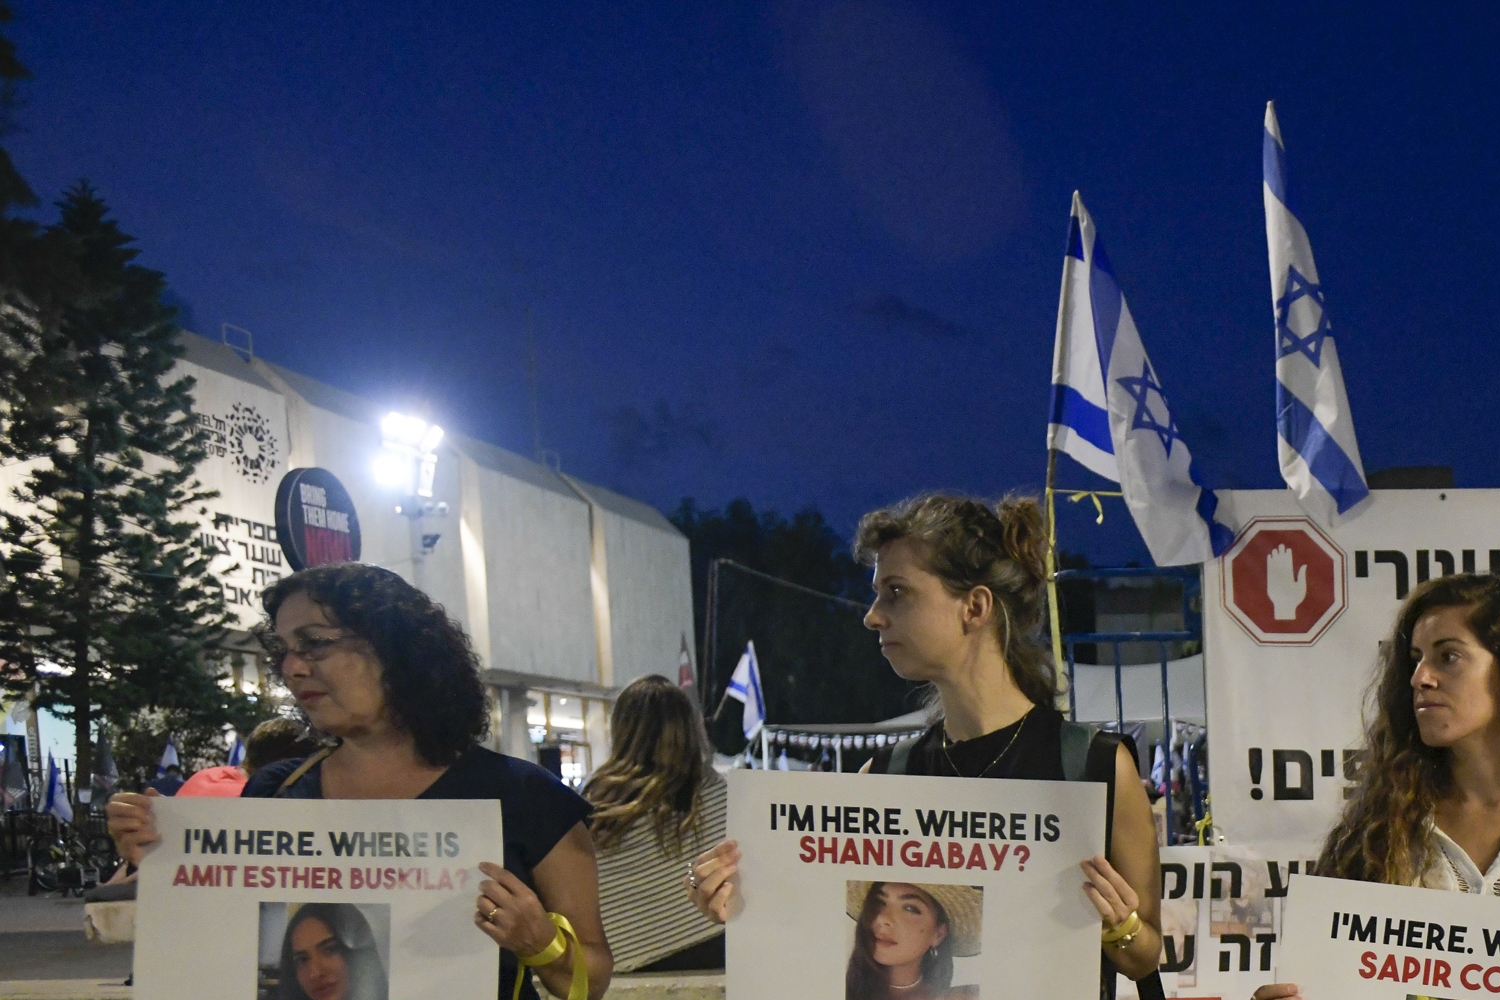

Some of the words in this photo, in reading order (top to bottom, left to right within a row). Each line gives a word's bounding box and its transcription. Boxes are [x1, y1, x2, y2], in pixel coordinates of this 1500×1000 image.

[302, 505, 326, 529] THEM
[326, 509, 350, 533] HOME
[770, 803, 815, 832] I'M
[821, 805, 909, 836] HERE.
[915, 809, 1027, 841] WHERE
[1034, 813, 1061, 842] IS
[184, 829, 228, 855] I'M
[234, 830, 322, 857] HERE.
[328, 831, 428, 858] WHERE
[436, 832, 460, 858] IS
[799, 836, 894, 867] SHANI
[900, 840, 1031, 872] GABAY?
[172, 864, 238, 887] AMIT
[243, 865, 343, 889] ESTHER
[350, 867, 470, 891] BUSKILA?
[1330, 912, 1378, 943] I'M
[1383, 918, 1474, 954] HERE.
[1358, 951, 1452, 989] SAPIR
